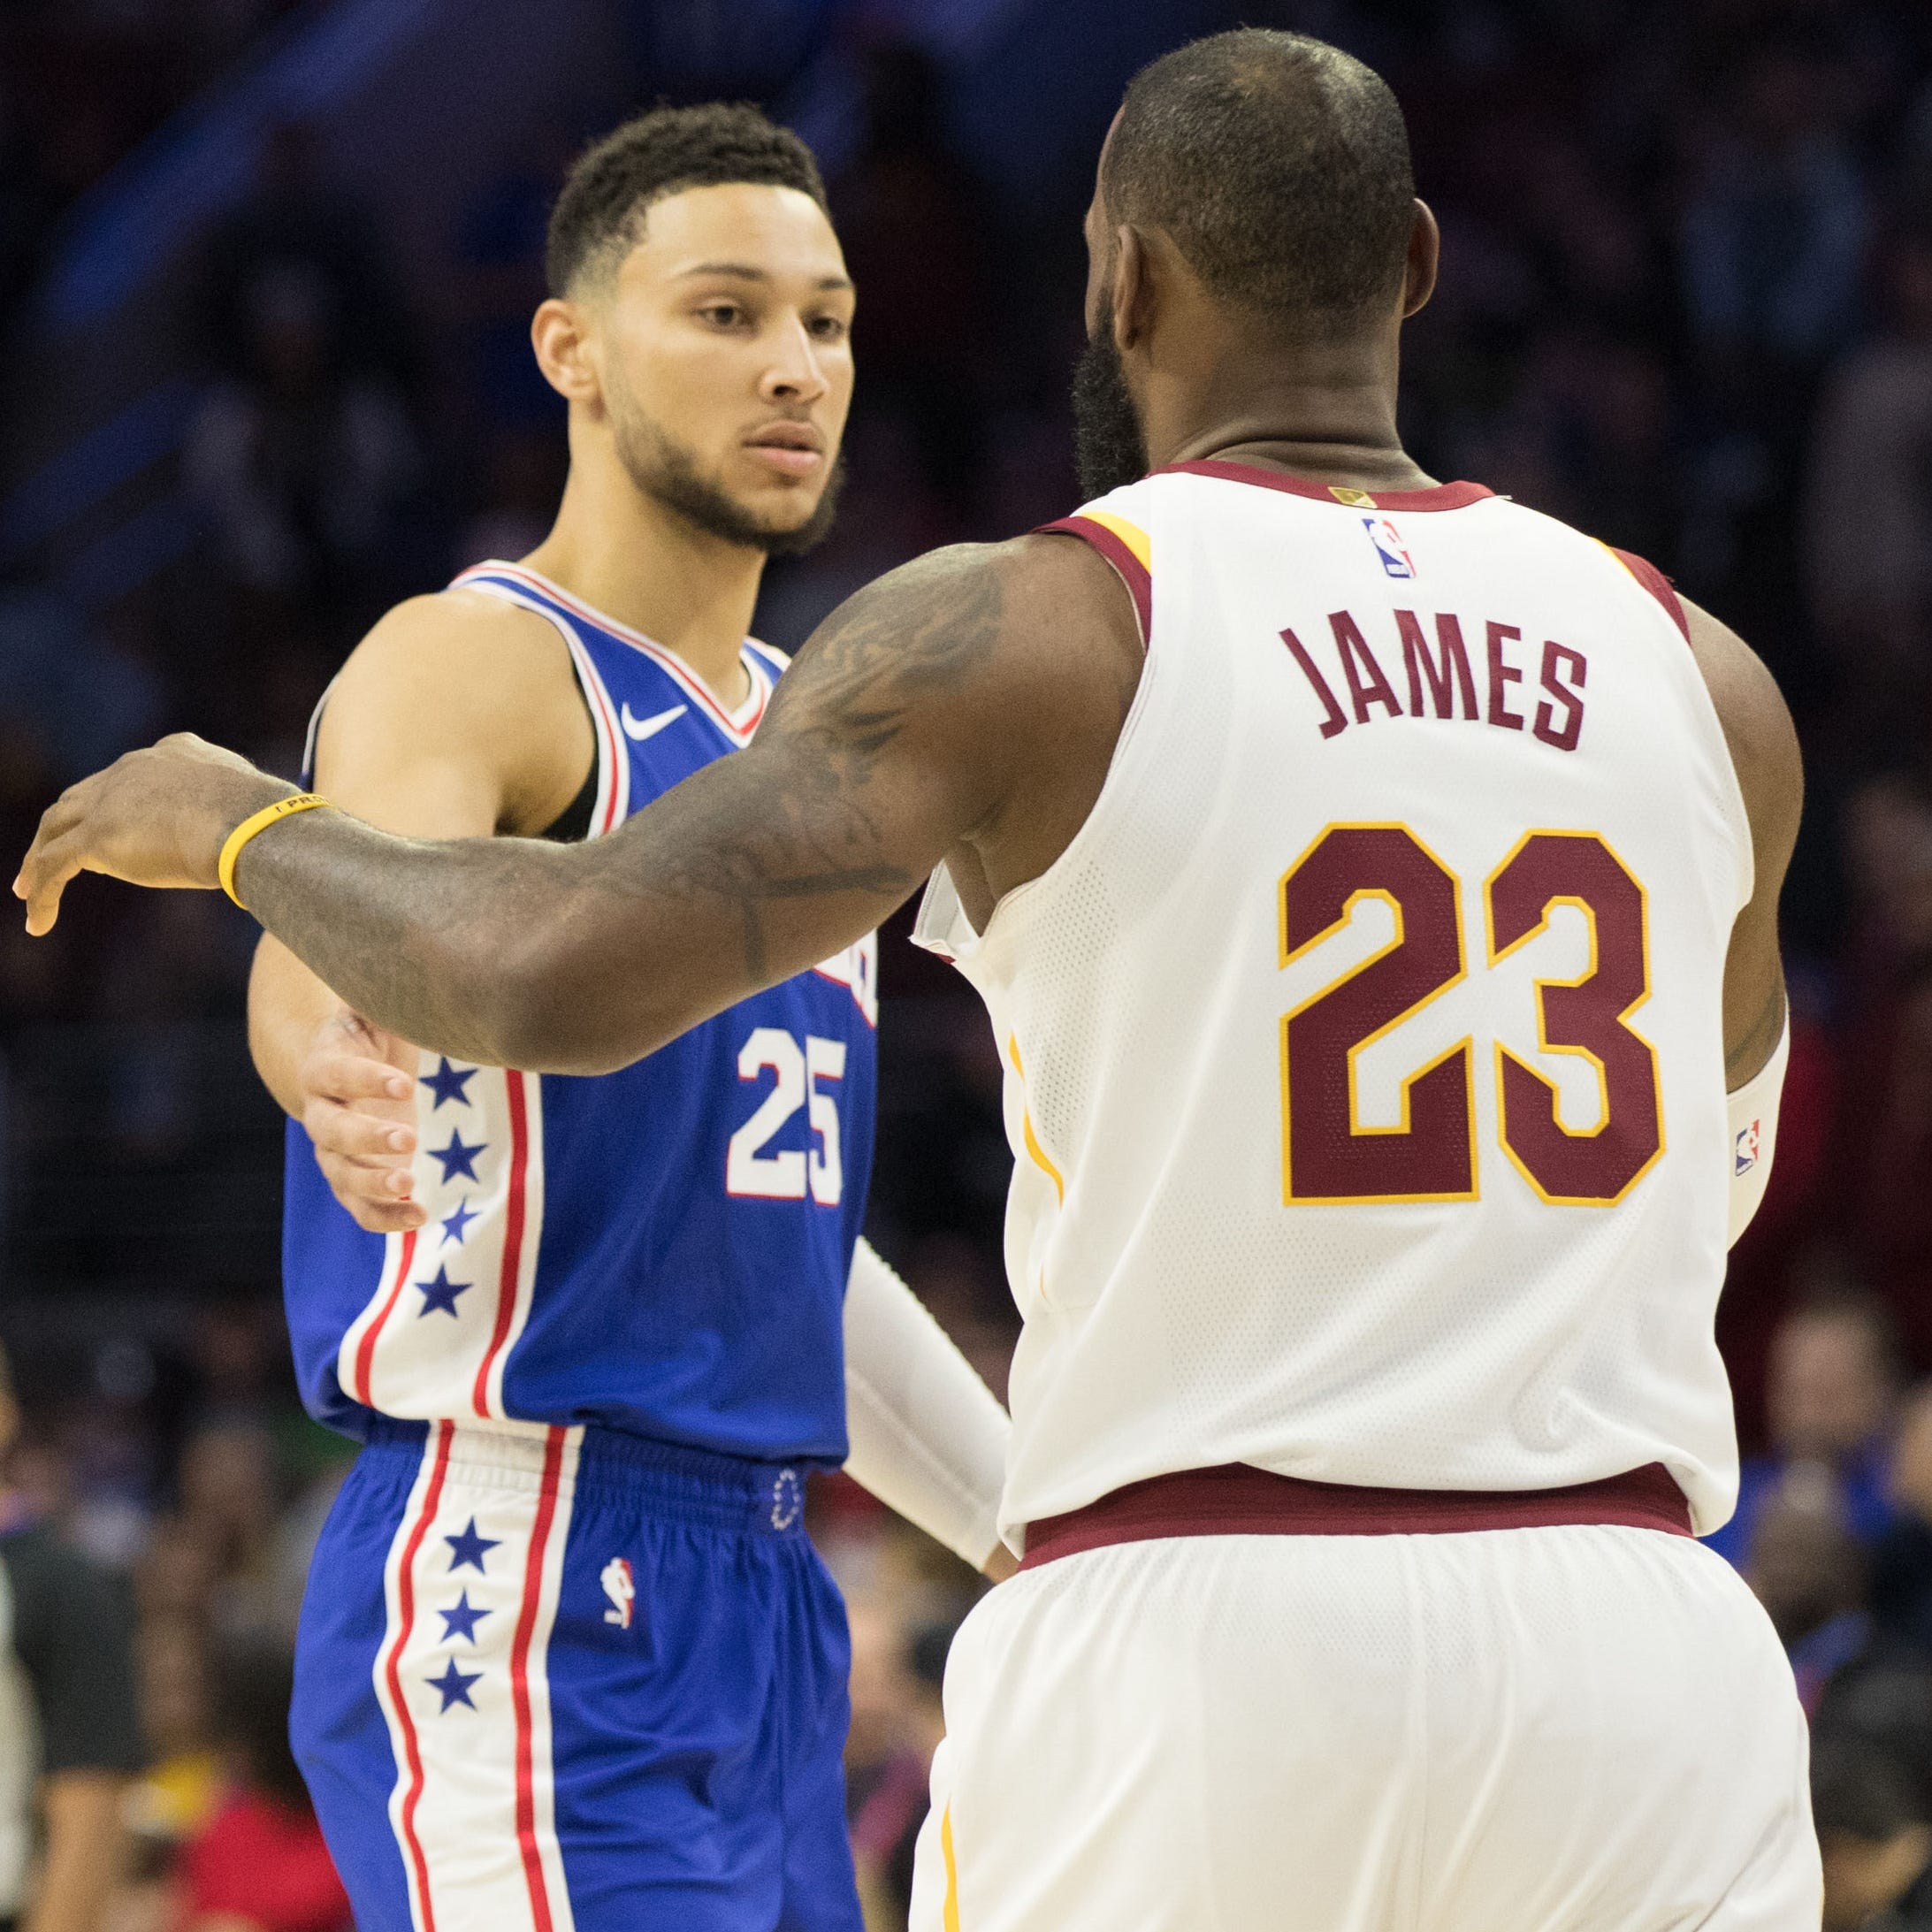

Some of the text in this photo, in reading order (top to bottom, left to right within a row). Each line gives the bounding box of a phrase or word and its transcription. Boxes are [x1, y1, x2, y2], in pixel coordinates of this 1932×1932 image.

[1279, 608, 1588, 752] JAMES
[1279, 821, 1666, 1208] 23
[725, 1027, 847, 1208] 25
